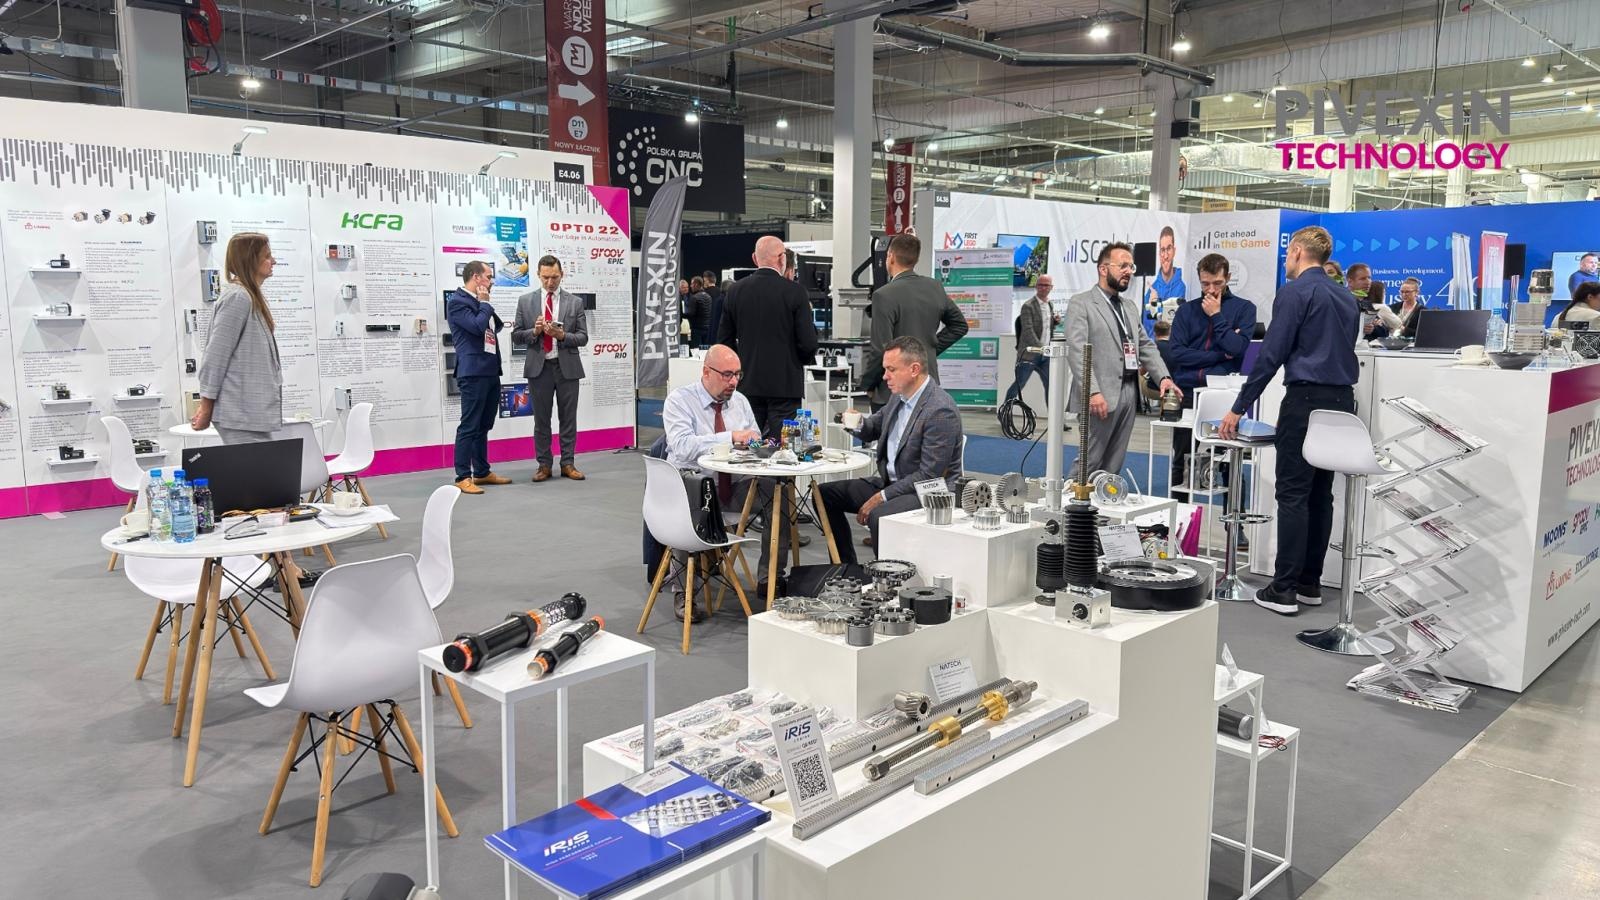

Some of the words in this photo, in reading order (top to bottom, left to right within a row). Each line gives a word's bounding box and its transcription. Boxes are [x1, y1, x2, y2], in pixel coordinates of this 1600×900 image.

[563, 0, 573, 30] WAR
[582, 0, 592, 33] WEE
[571, 119, 584, 128] D11
[574, 130, 584, 138] E7
[554, 140, 575, 150] NOWY
[646, 146, 676, 158] POLSKA
[677, 149, 703, 161] GRUPA
[558, 168, 581, 180] E4.06
[645, 157, 704, 188] CNC
[550, 222, 594, 234] OPTO
[598, 225, 619, 235] 22
[1213, 230, 1229, 239] Get
[1230, 229, 1256, 238] ahead
[566, 234, 580, 242] Edge
[963, 239, 977, 247] LEGO
[1221, 239, 1237, 249] the
[1240, 238, 1271, 249] Game
[590, 247, 625, 260] groov
[607, 257, 625, 265] EPIC
[663, 233, 679, 357] TECHNOLOGY
[593, 342, 628, 356] groov
[816, 347, 842, 358] CNC
[939, 659, 962, 671] NATECH
[543, 830, 590, 857] iRiS
